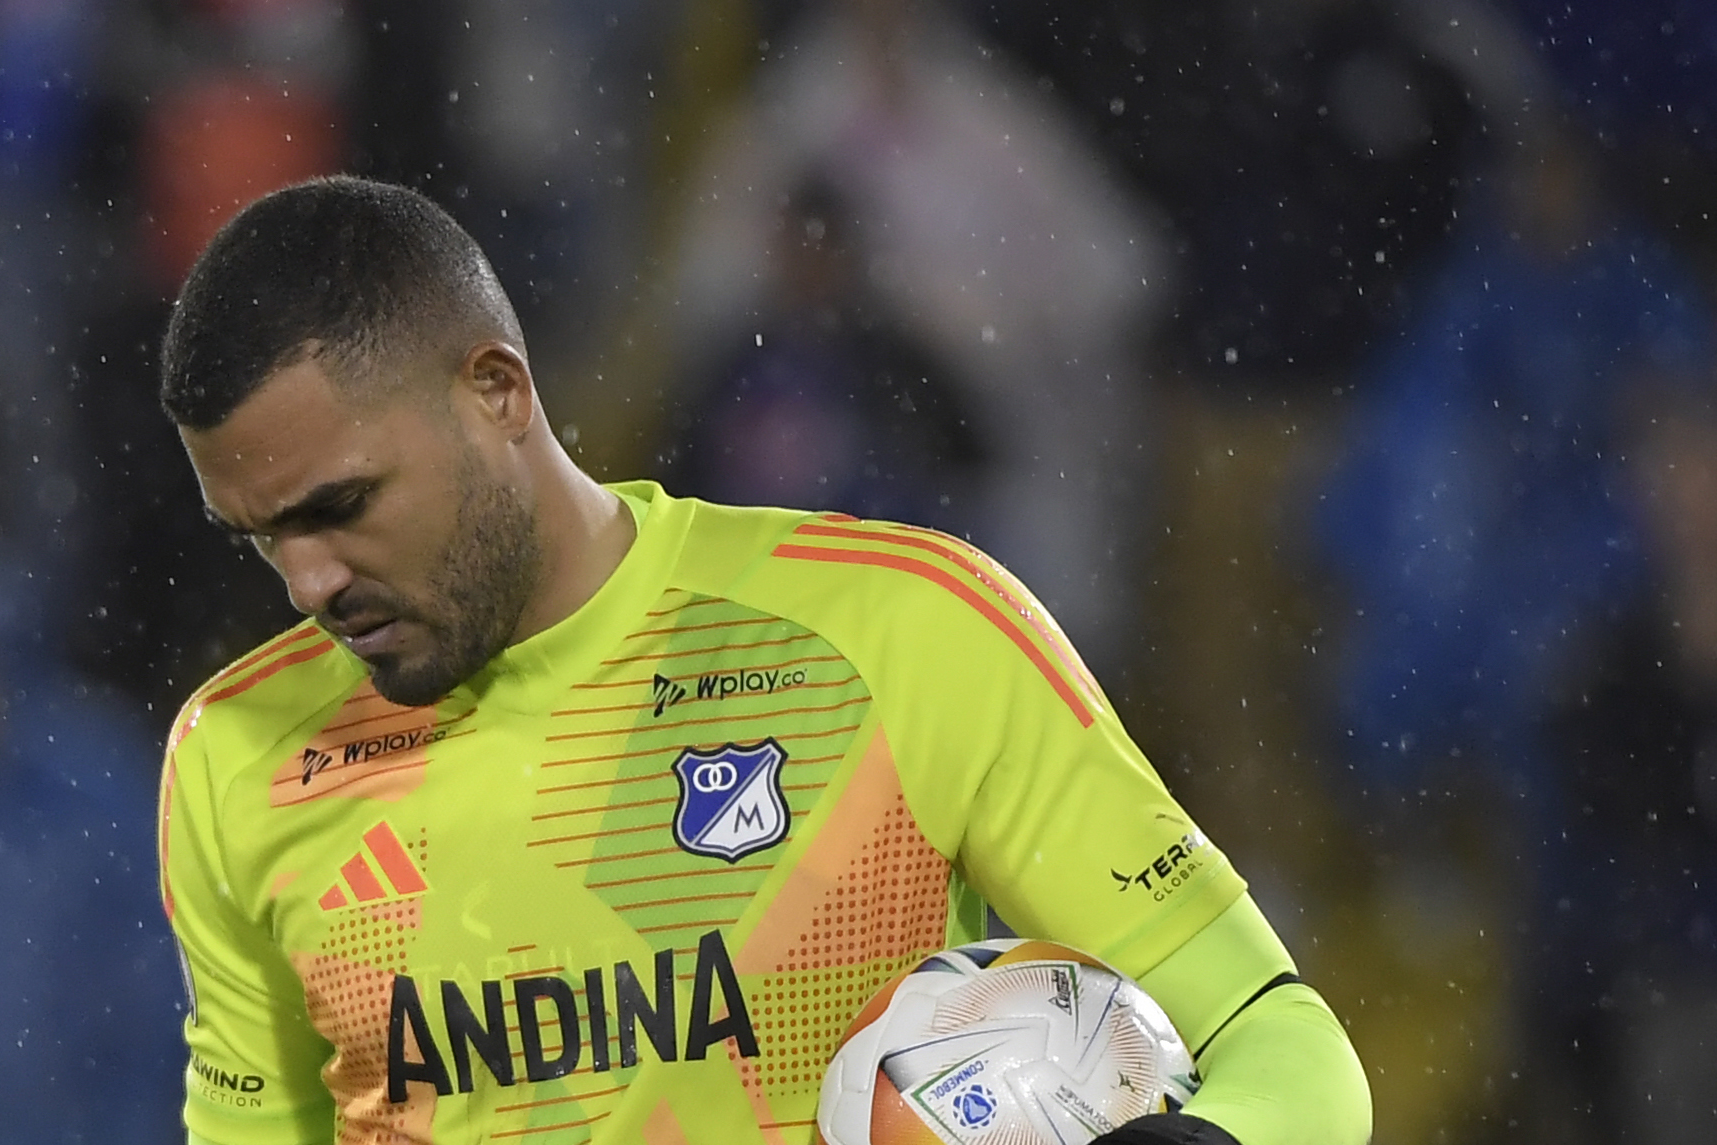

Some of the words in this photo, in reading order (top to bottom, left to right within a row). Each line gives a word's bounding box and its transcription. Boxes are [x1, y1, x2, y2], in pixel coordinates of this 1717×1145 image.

[697, 669, 806, 700] Wplay.co
[1153, 860, 1204, 903] GLOBAL
[387, 928, 761, 1105] ANDINA
[929, 1060, 985, 1100] CONMEBOL
